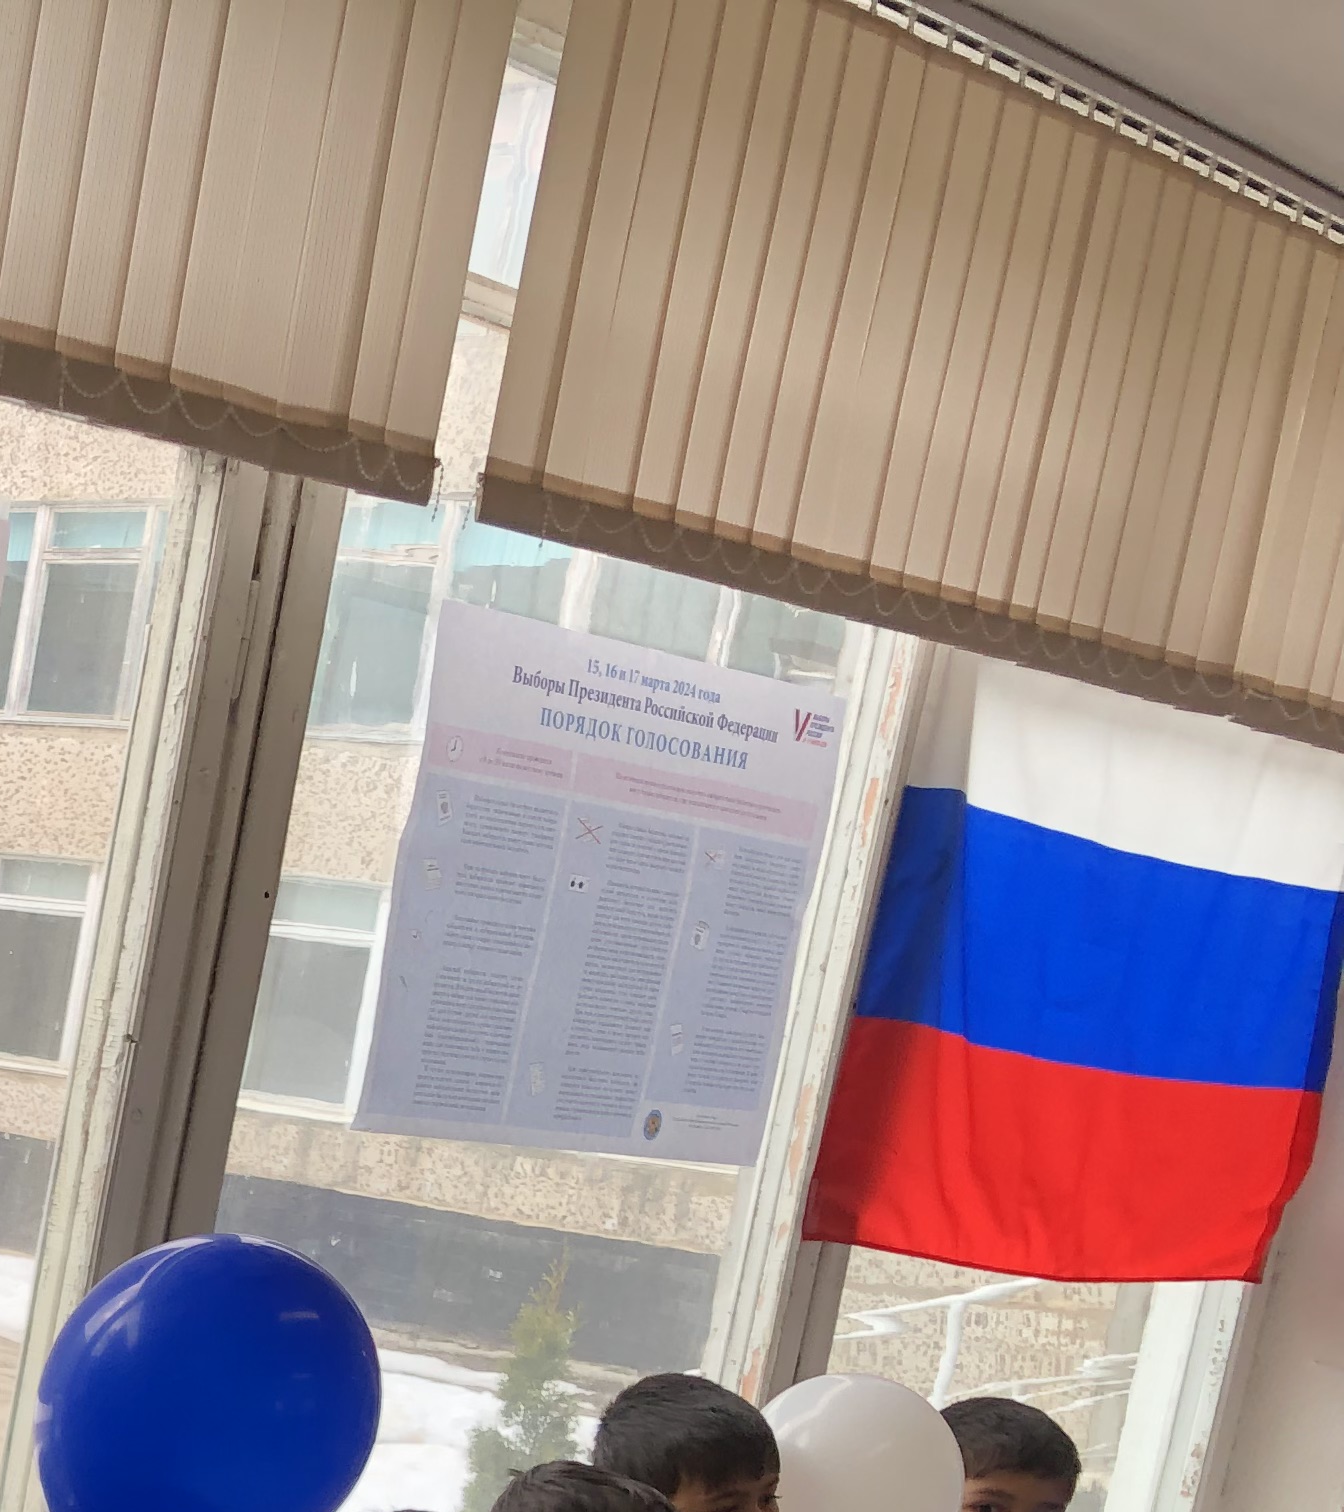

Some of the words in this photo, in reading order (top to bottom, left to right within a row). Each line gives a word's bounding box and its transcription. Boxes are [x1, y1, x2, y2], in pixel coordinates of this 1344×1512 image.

[510, 663, 567, 700] Выборы
[565, 677, 643, 718] Президента
[642, 695, 715, 729] Российской
[714, 712, 779, 748] Федерации
[585, 657, 604, 677] 15,
[604, 662, 619, 679] 16
[627, 668, 641, 684] 17
[639, 674, 671, 696] марта
[671, 679, 697, 698] 2024
[696, 687, 721, 705] года
[537, 706, 623, 746] ПОРЯДОК
[624, 725, 749, 771] ГОЛОСОВАНИЯ
